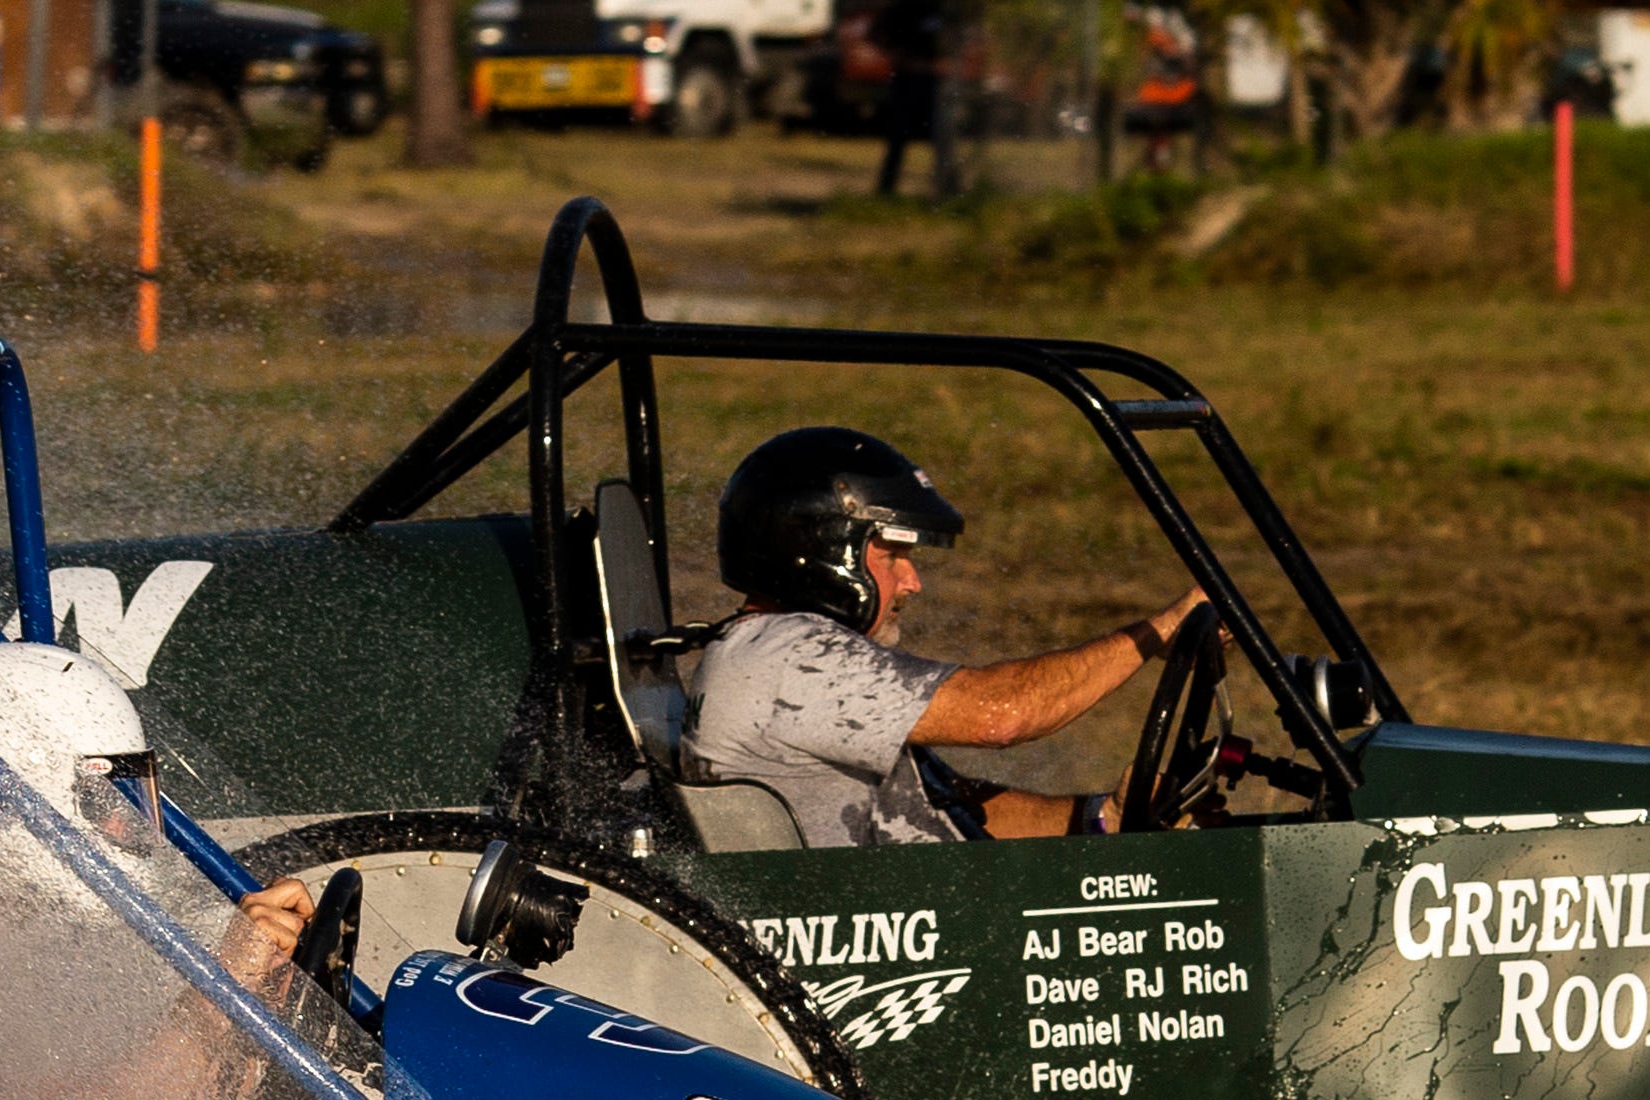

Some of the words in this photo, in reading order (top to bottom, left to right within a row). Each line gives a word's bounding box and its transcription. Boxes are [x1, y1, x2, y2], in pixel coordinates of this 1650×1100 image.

[1080, 873, 1159, 901] CREW:
[737, 909, 941, 968] ENLING
[1022, 928, 1062, 961] AJ
[1078, 923, 1148, 958] Bear
[1164, 919, 1225, 952] Rob
[1025, 973, 1101, 1005] Dave
[1125, 966, 1165, 999] RJ
[1181, 961, 1249, 996] Rich
[1493, 960, 1650, 1054] ROO
[1028, 1012, 1122, 1049] Daniel
[1138, 1009, 1225, 1043] Nolan
[1031, 1057, 1134, 1096] Freddy
